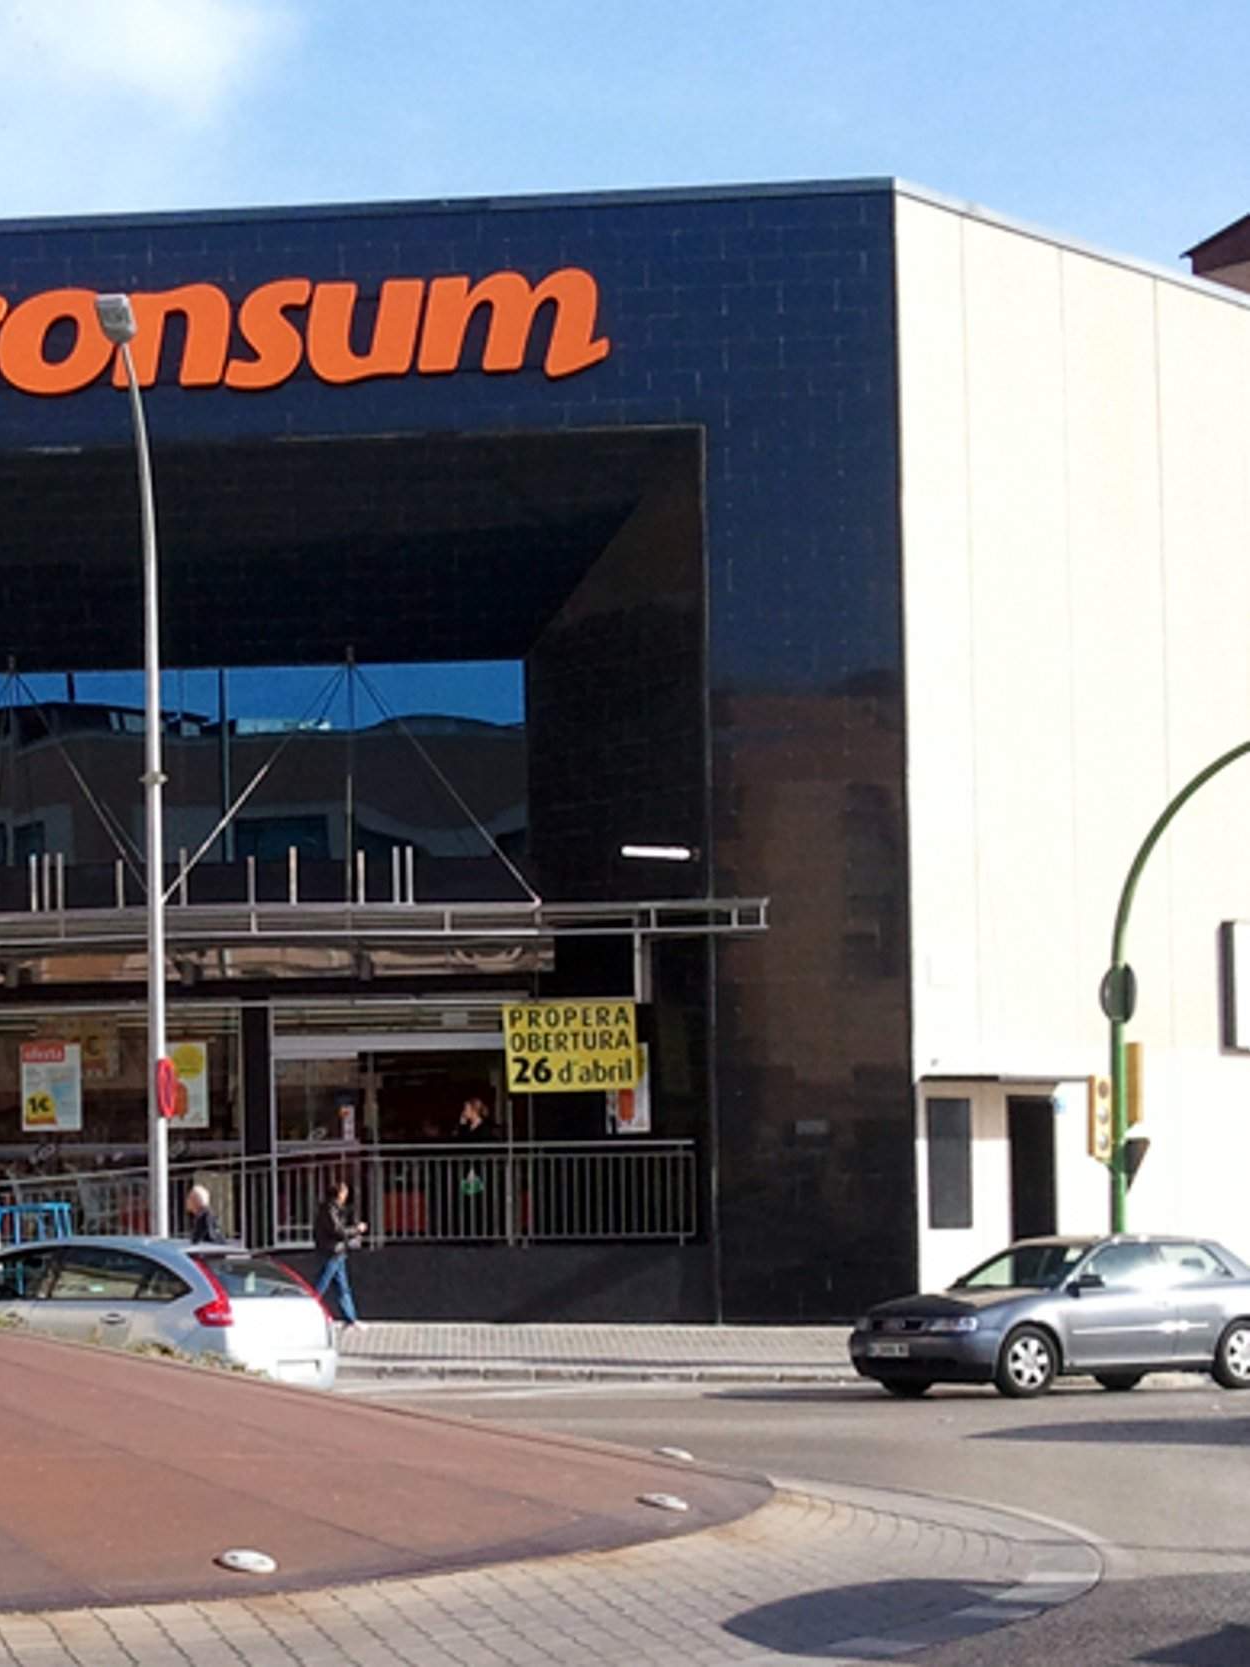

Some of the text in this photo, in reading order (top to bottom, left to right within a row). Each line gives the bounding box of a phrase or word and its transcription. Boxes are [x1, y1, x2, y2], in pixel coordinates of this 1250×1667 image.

[508, 1006, 630, 1028] PROPERA
[511, 1030, 631, 1053] OBERTURA
[512, 1057, 552, 1084] 26
